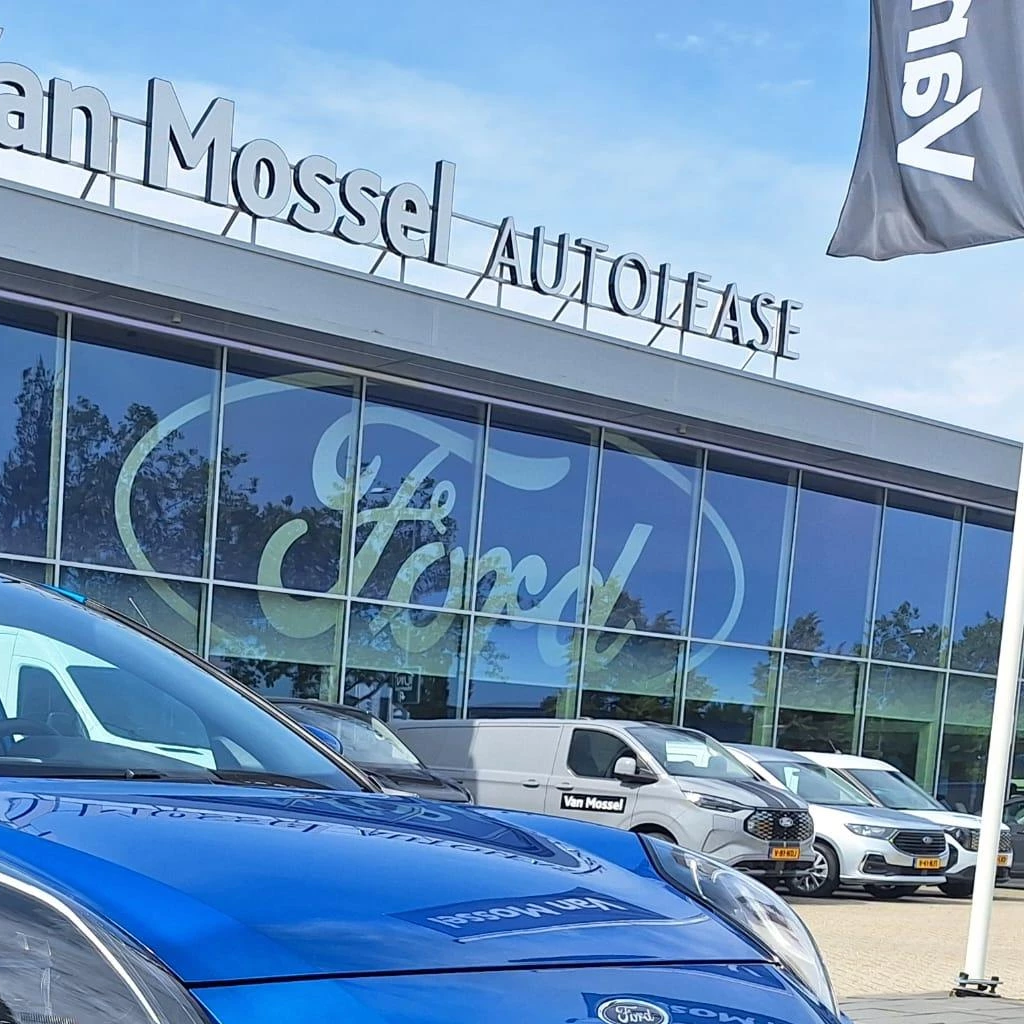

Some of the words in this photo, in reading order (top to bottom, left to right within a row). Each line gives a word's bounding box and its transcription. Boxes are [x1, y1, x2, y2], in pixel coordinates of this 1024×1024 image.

[143, 76, 457, 266] Mossel
[485, 216, 804, 360] AUTOLEASE
[257, 406, 654, 668] Ford
[563, 795, 584, 808] Van
[585, 796, 624, 811] Mossel
[427, 903, 562, 929] Mossel
[615, 1004, 656, 1024] Ford
